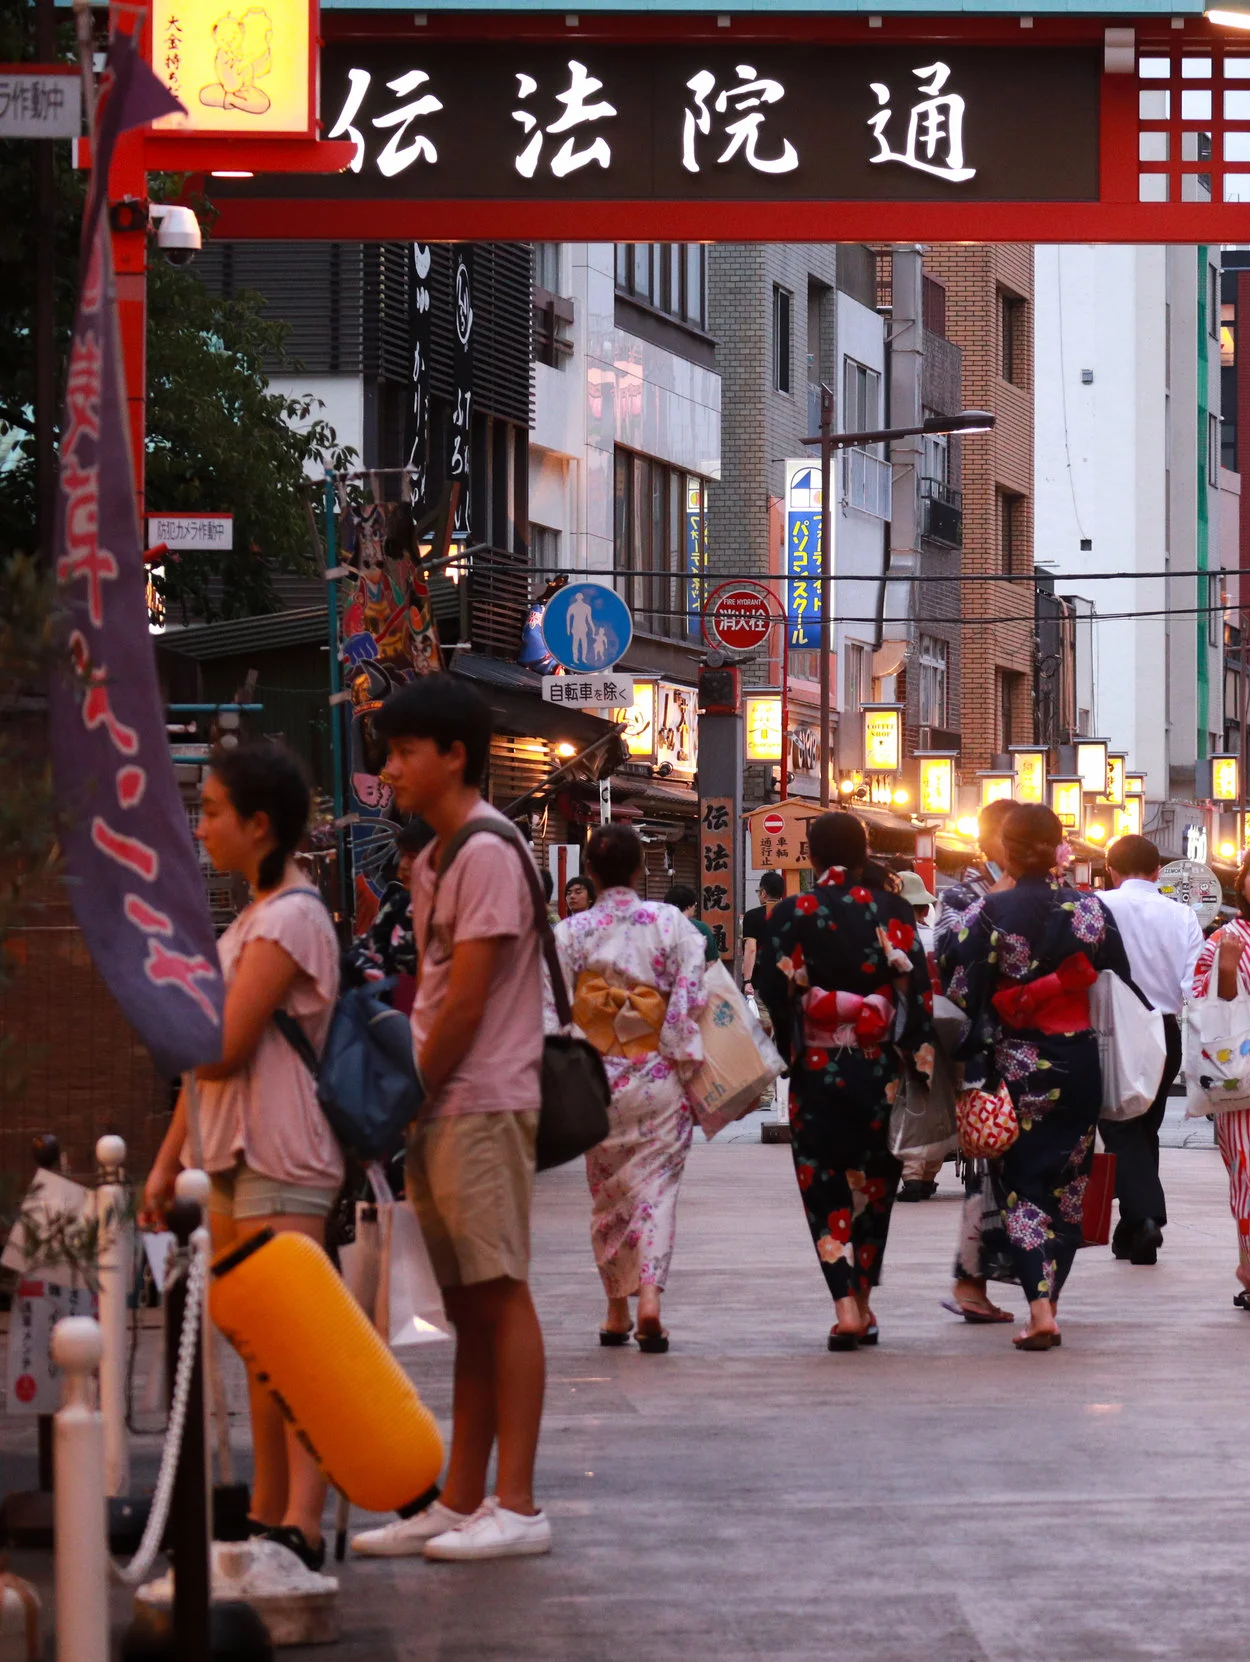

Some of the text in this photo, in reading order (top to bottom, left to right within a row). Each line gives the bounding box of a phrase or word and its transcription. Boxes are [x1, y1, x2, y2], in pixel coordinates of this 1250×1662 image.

[328, 60, 977, 183] 伝法院通
[157, 520, 225, 541] 防犯カメラ作動中
[791, 519, 810, 645] パソコンスクール
[723, 598, 762, 606] FIRE HYDRANT
[719, 608, 767, 631] 消火栓
[550, 681, 628, 702] 自転車を除く
[760, 837, 773, 866] 通行止
